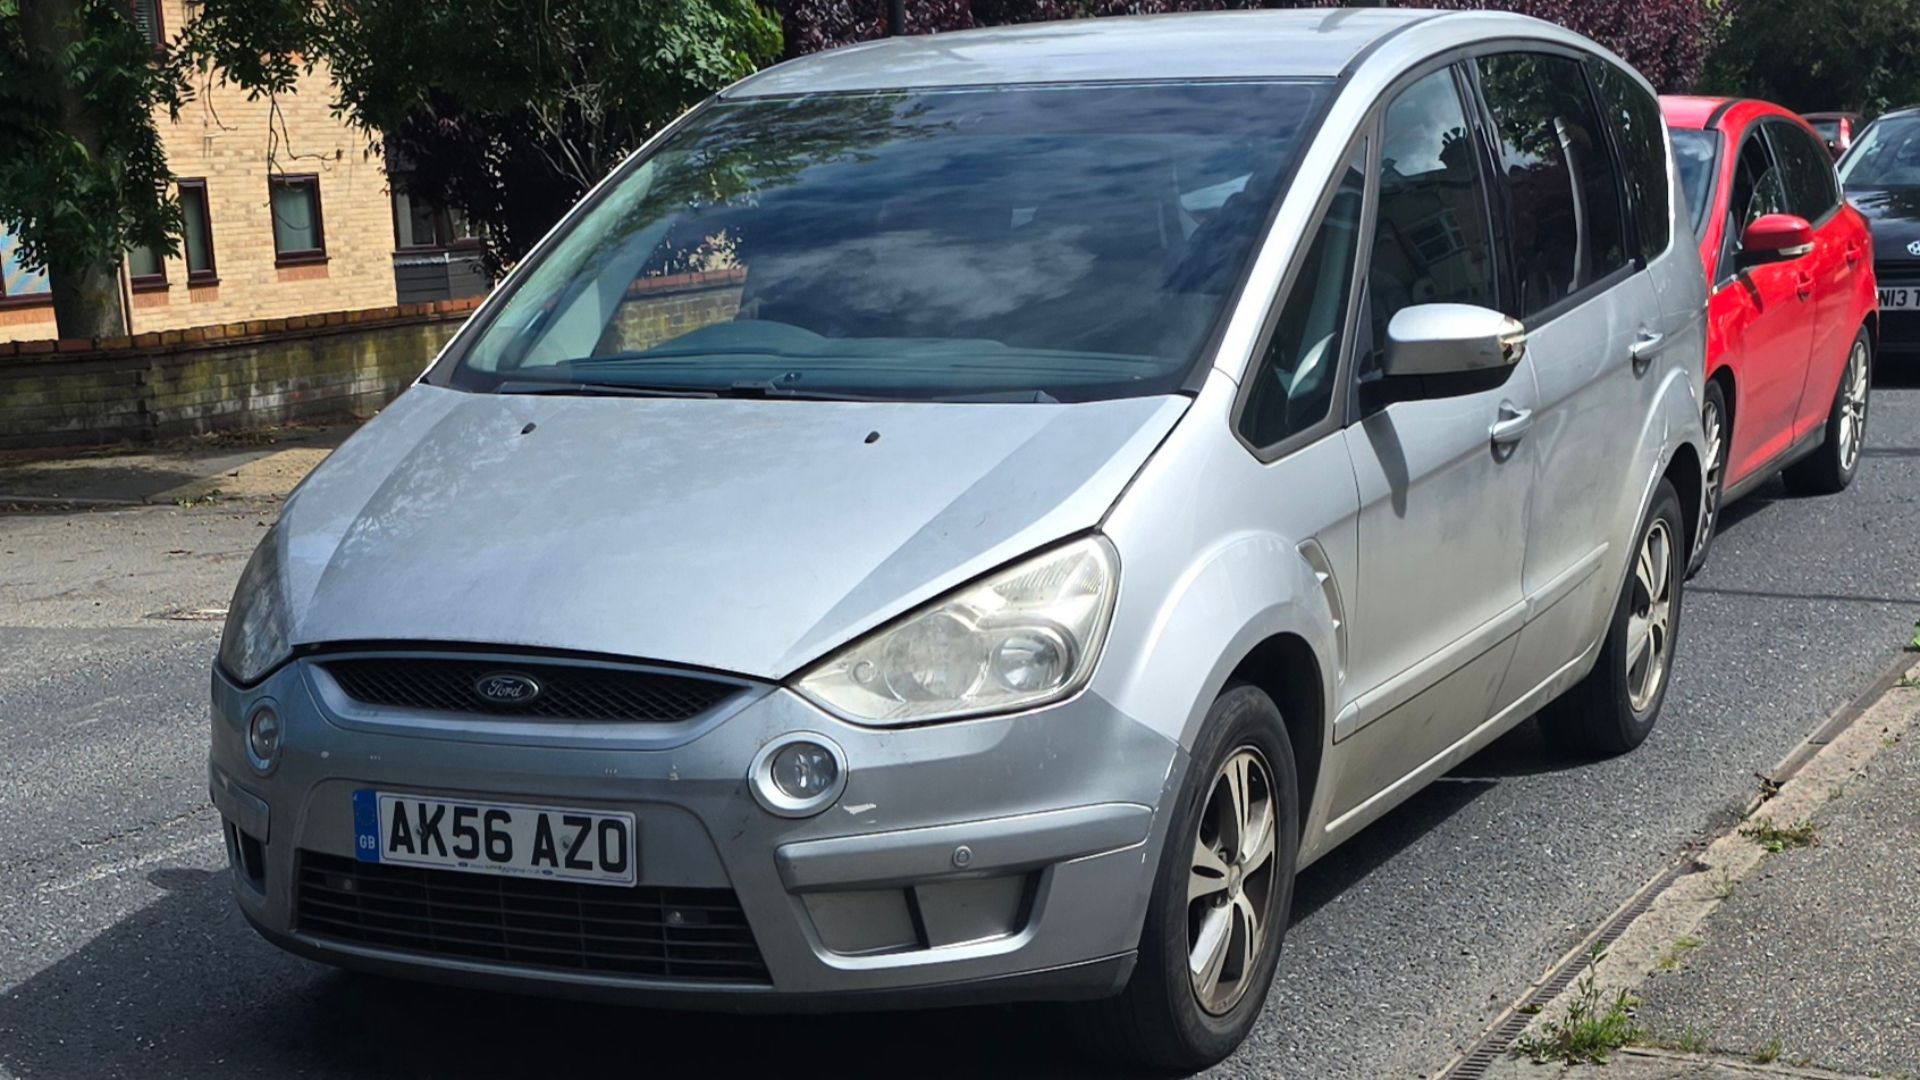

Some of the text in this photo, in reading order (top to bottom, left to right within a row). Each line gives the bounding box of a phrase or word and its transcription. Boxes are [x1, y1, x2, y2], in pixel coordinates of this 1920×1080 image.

[488, 678, 524, 697] Ford
[360, 834, 376, 850] GB
[389, 801, 627, 873] AK56 AZO
